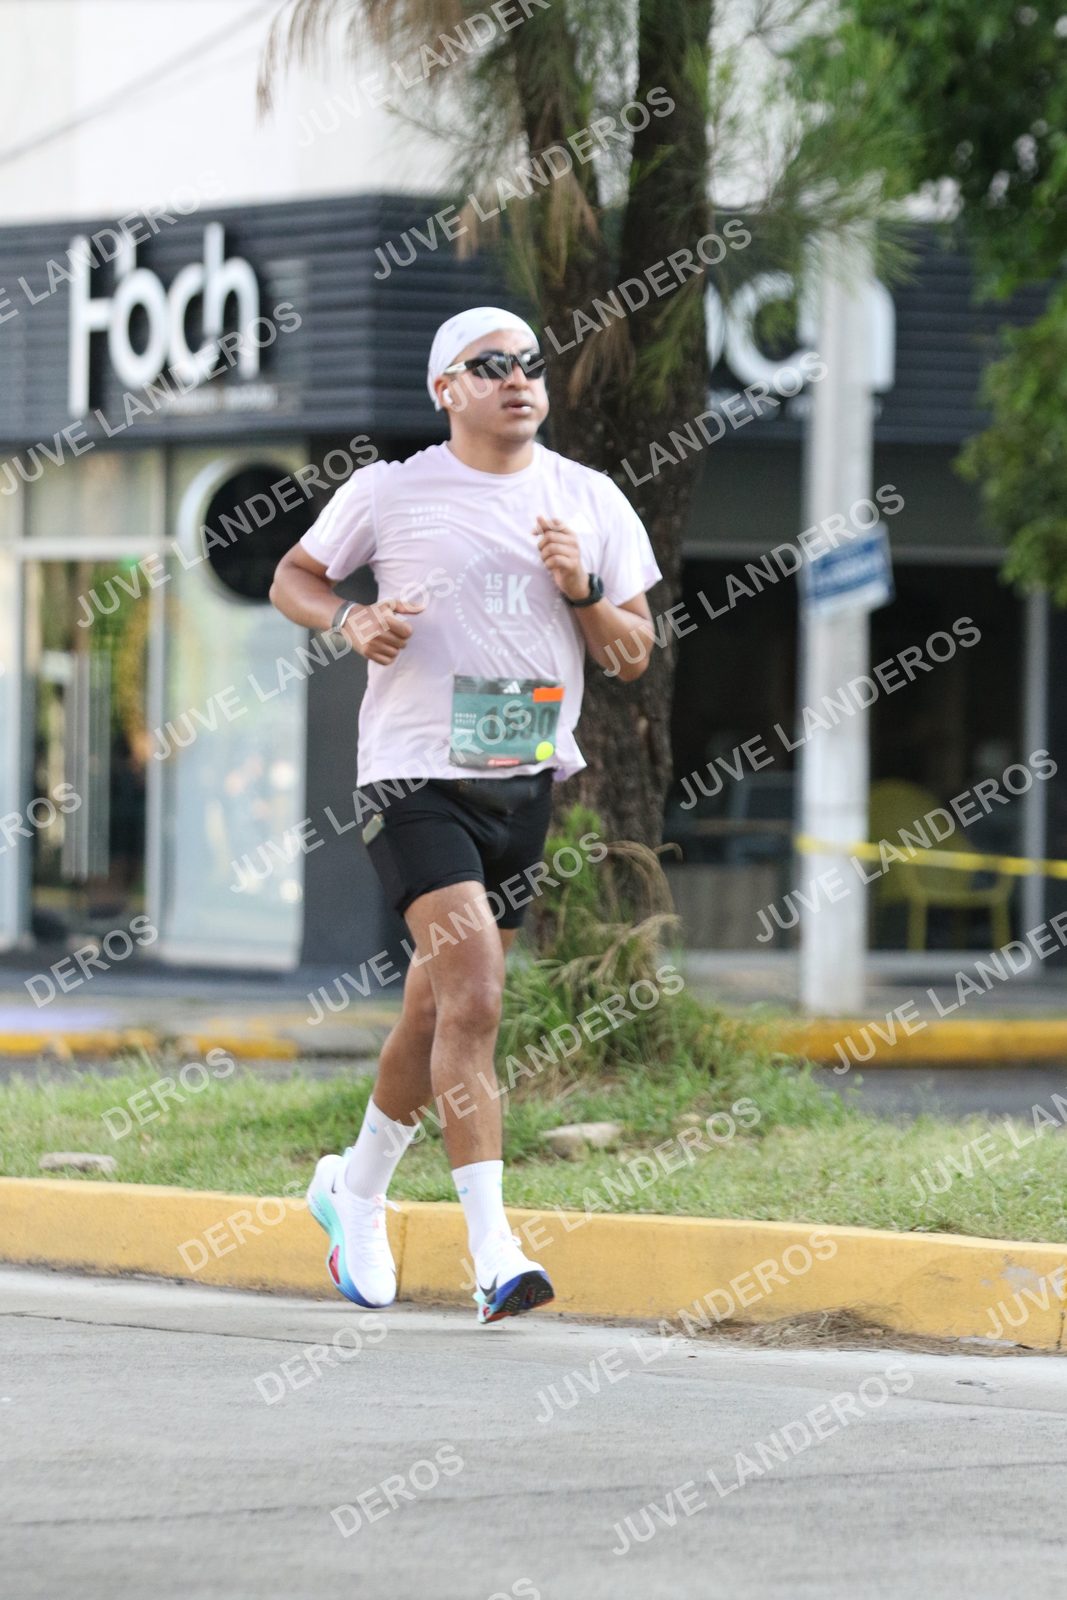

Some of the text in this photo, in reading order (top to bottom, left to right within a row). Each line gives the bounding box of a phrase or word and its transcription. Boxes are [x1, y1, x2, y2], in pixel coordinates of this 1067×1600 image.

[485, 573, 503, 590] 15
[507, 574, 532, 616] K
[484, 597, 503, 614] 30
